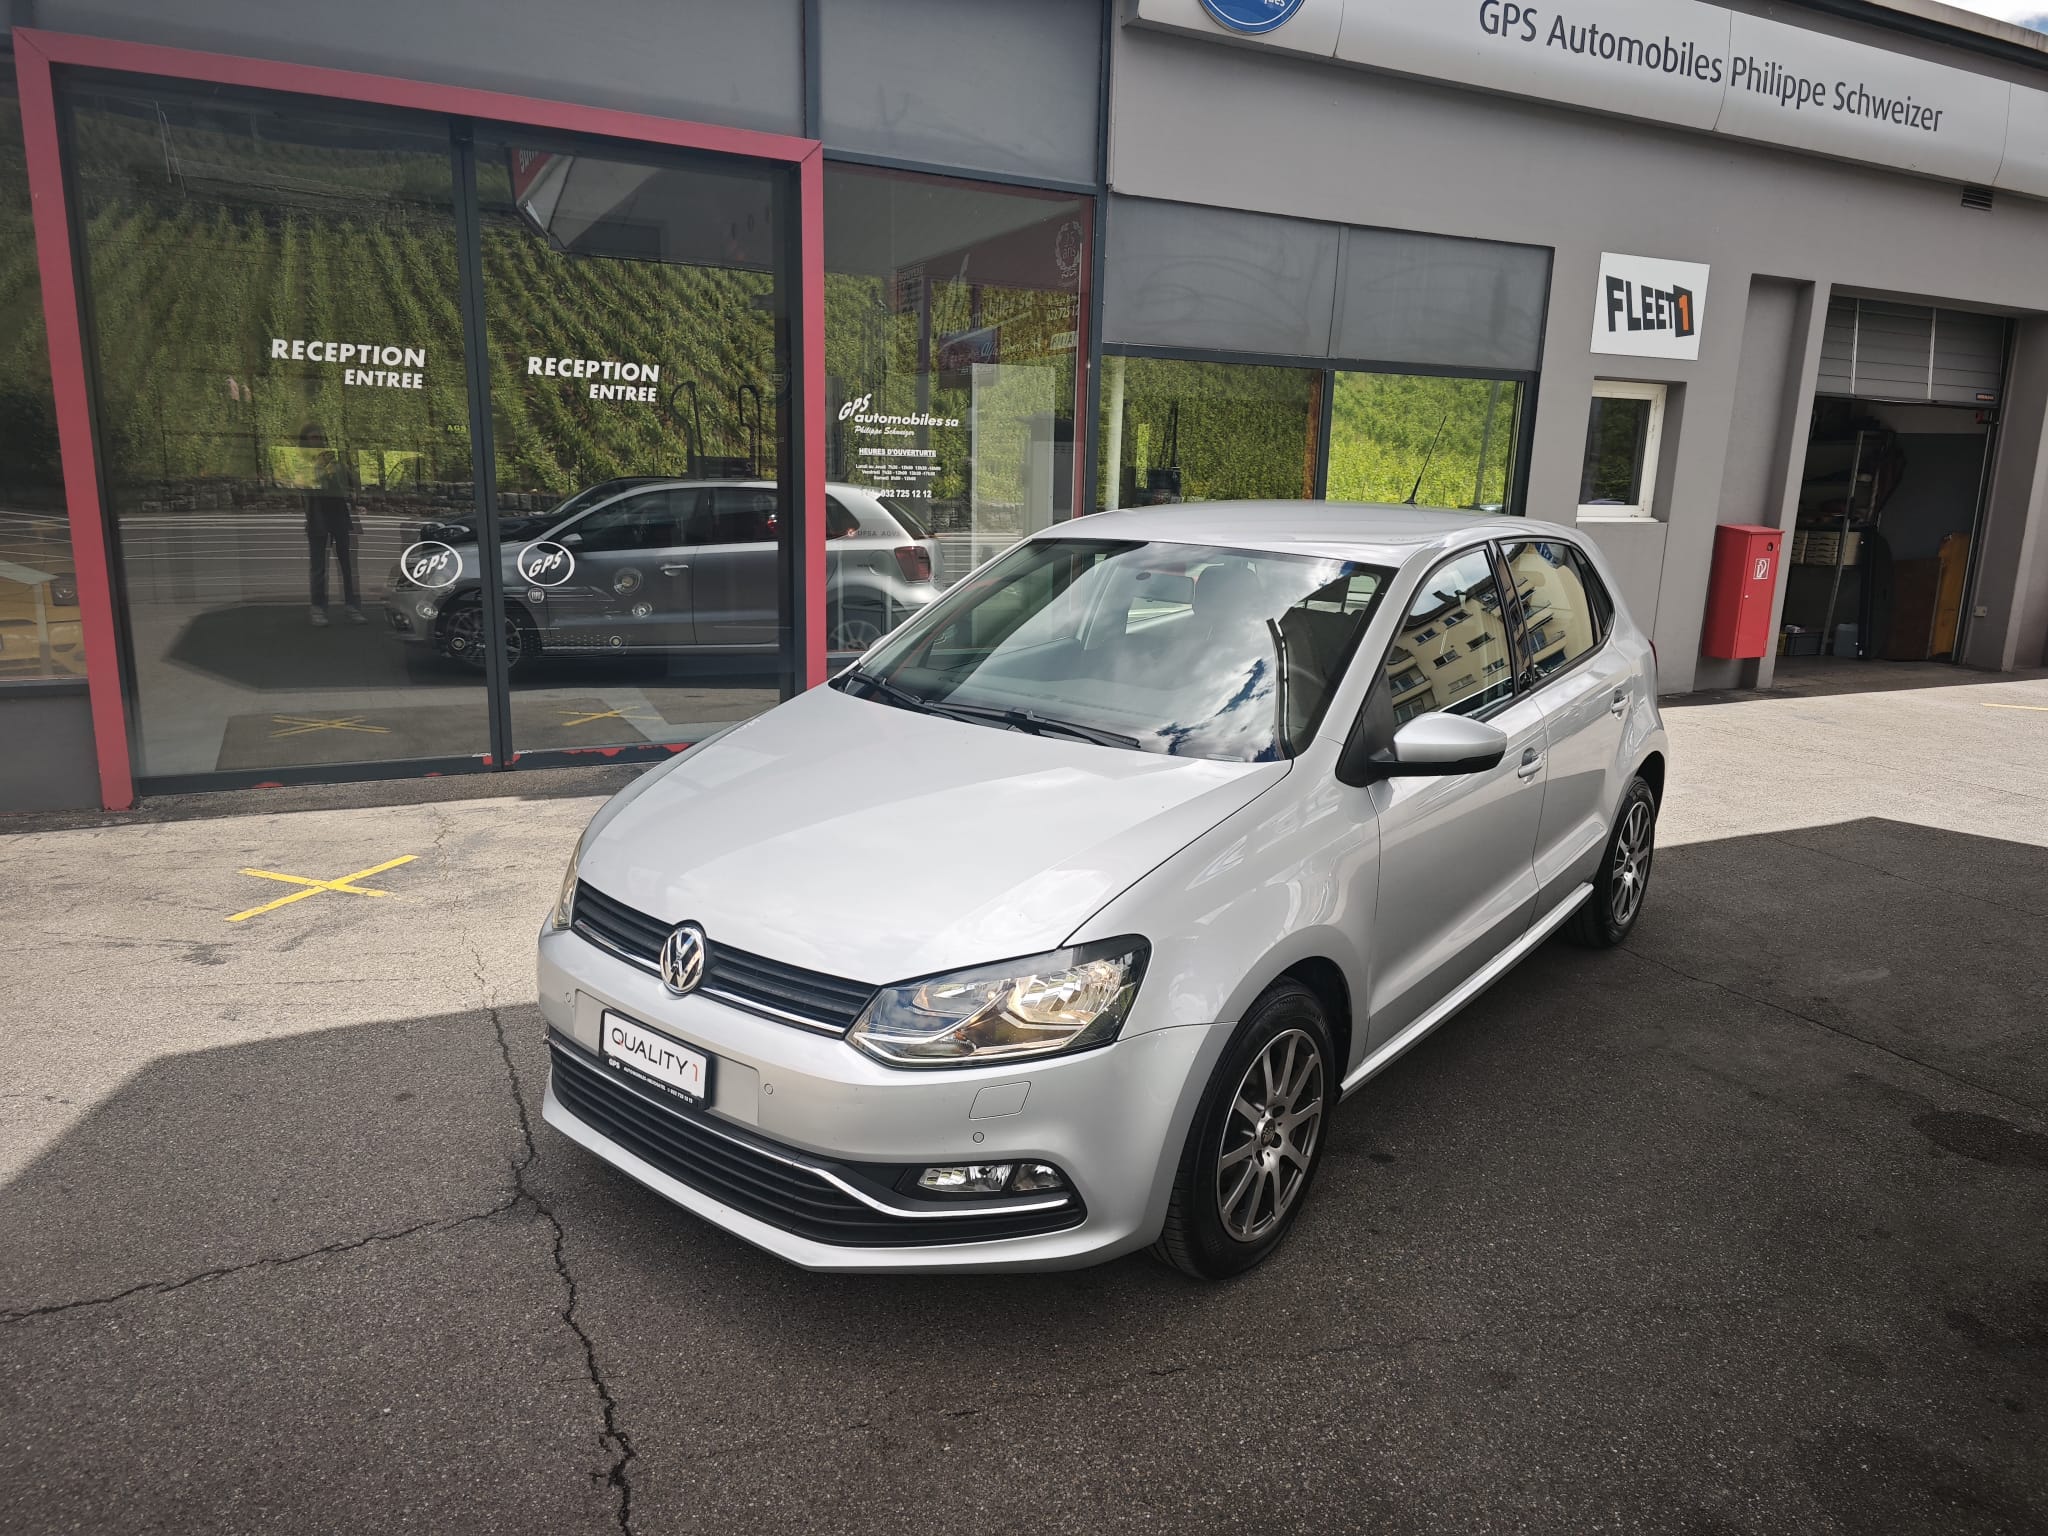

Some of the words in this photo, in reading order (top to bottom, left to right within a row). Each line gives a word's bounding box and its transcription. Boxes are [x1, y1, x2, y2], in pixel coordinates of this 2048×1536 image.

[1479, 0, 1537, 42] GPS
[1547, 14, 1723, 83] Automobiles
[1731, 56, 1826, 110] Philippe
[1834, 81, 1943, 132] Schweizer
[271, 338, 426, 368] RECEPTION
[344, 369, 424, 389] ENTREE
[527, 356, 660, 382] RECEPTION
[589, 384, 657, 402] ENTREE
[838, 393, 872, 420] GPS
[855, 412, 942, 426] automobiles
[944, 419, 959, 427] sa
[859, 447, 885, 456] HEURES
[880, 489, 895, 498] 032
[896, 489, 910, 498] 725
[912, 490, 921, 498] 12
[922, 490, 932, 498] 12
[413, 550, 450, 579] GPS
[529, 550, 563, 578] GPS
[612, 1027, 688, 1076] QUALITY
